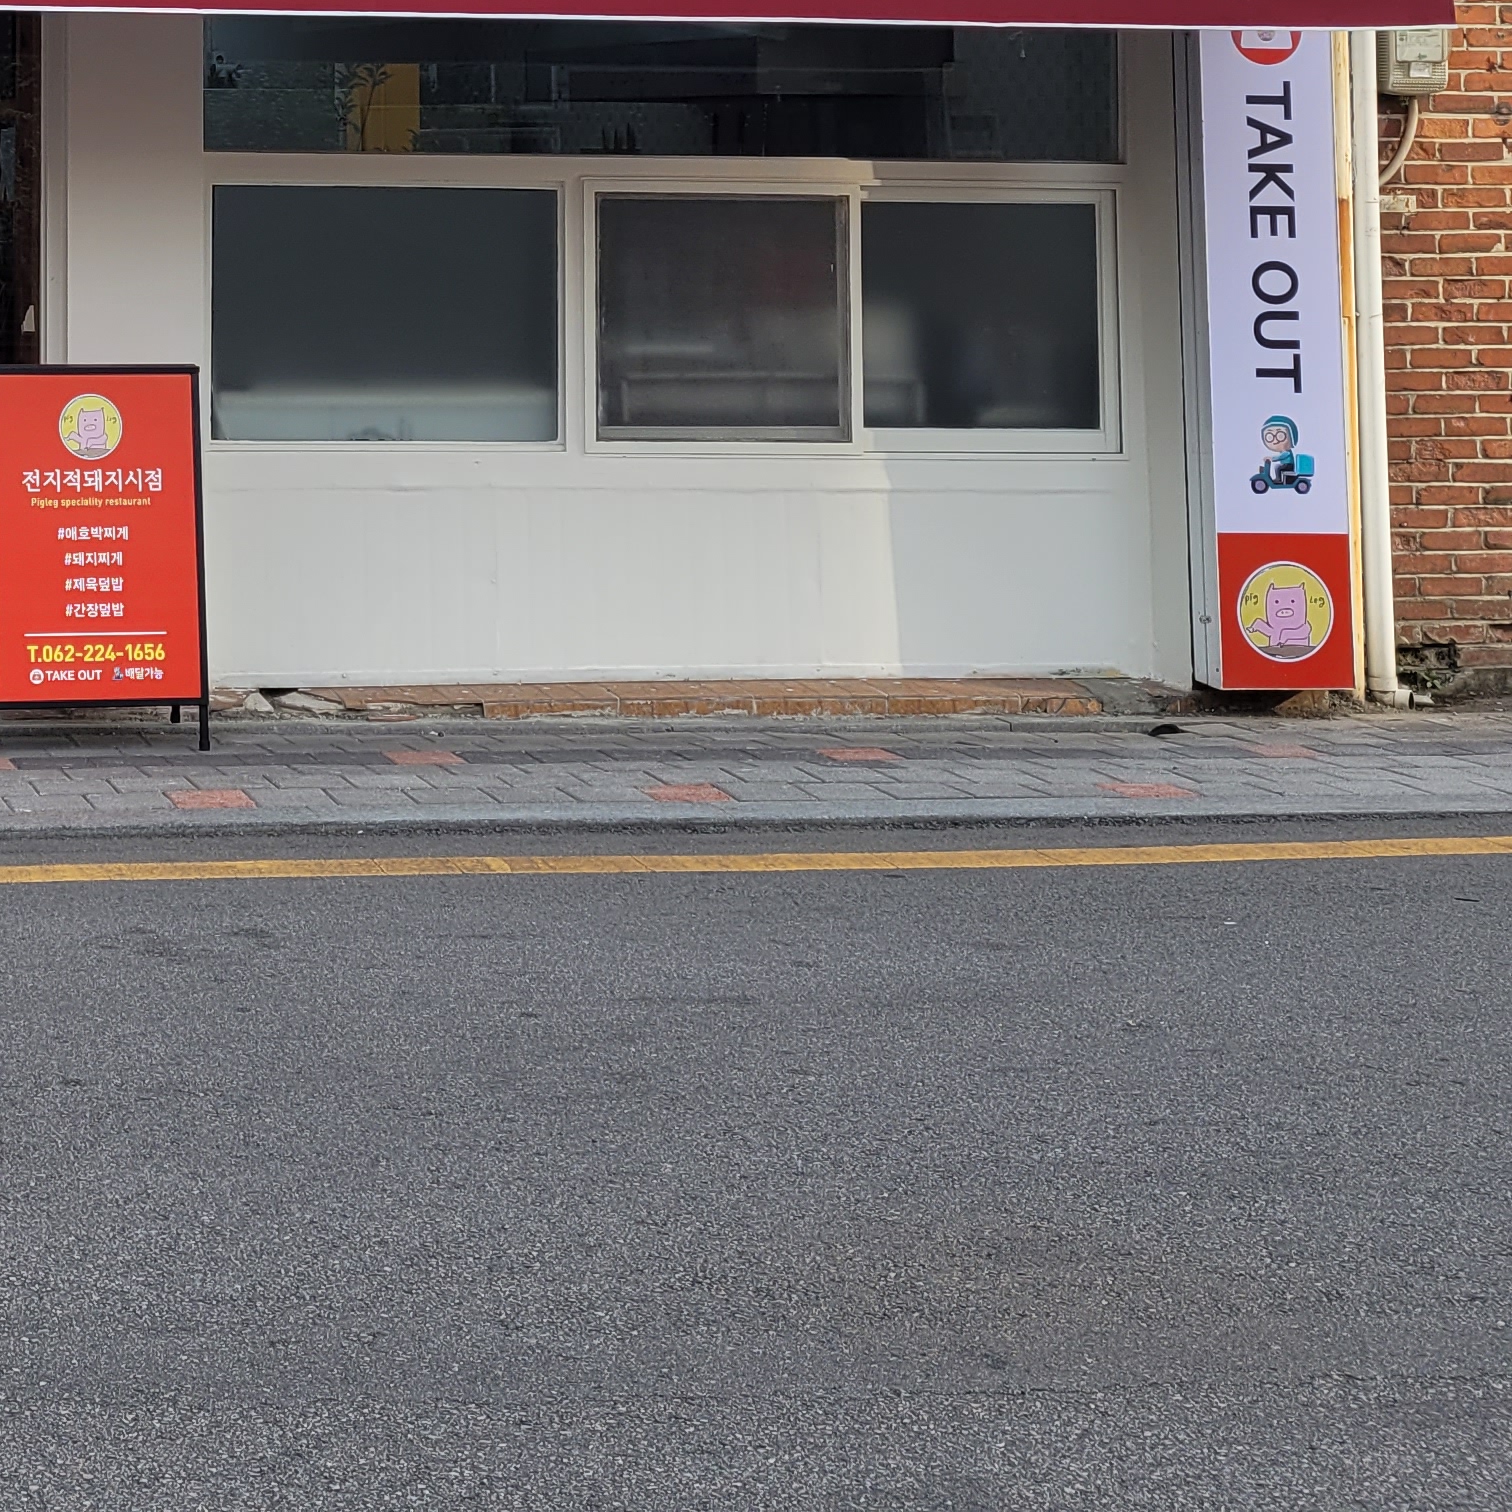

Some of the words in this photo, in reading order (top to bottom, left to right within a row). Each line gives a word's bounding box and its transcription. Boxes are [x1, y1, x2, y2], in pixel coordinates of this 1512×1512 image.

[1245, 80, 1296, 240] TAKE
[1251, 260, 1302, 394] OUT
[21, 467, 163, 493] 전지적돼지시점
[30, 496, 59, 509] Pigleg
[60, 496, 103, 508] speciality
[104, 495, 151, 507] restaurant
[57, 525, 129, 541] #애호박찌게
[64, 551, 123, 567] #돼지찌게
[64, 576, 124, 592] #제육덮밥
[65, 601, 125, 618] #간장덮밥
[26, 643, 166, 663] T.062-224-1656
[45, 669, 76, 682] TAKE
[77, 669, 103, 681] OUT
